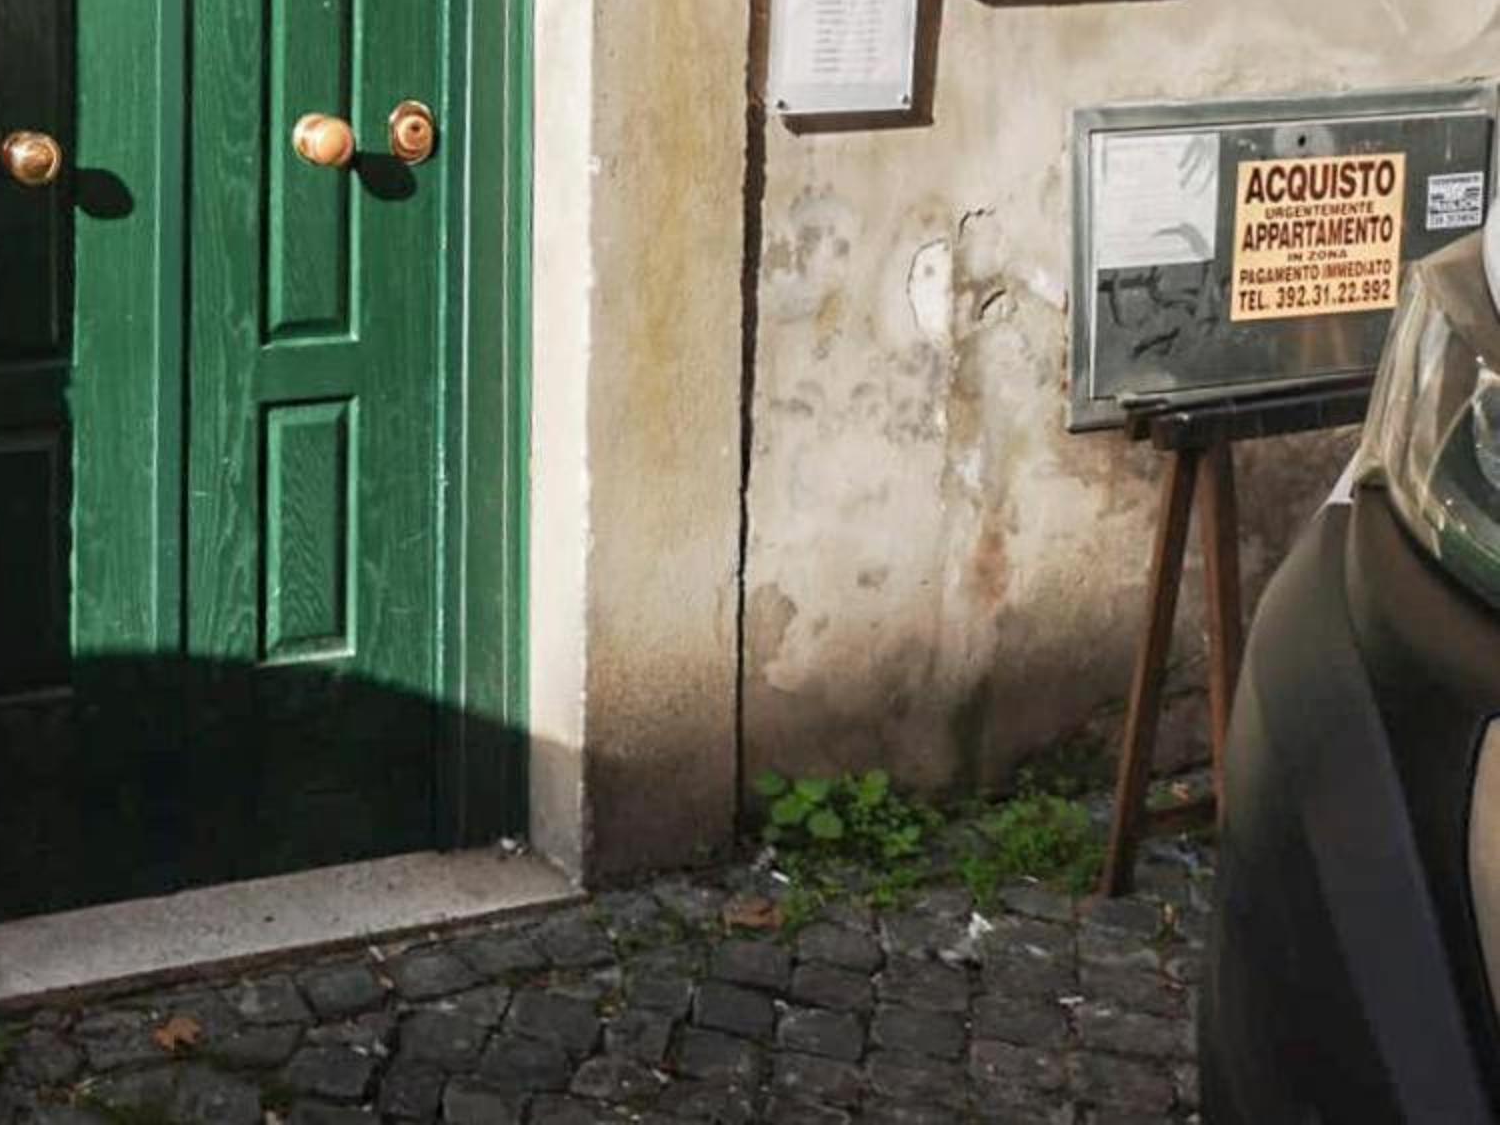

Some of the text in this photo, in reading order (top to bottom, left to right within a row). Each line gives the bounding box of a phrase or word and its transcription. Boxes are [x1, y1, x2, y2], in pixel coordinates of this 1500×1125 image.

[1245, 159, 1395, 204] ACQUISTO
[1265, 201, 1375, 219] URGENTEMENTE
[1242, 214, 1393, 251] APPARTAMENTO
[1287, 249, 1348, 262] IN ZONA
[1239, 259, 1392, 285] PAGAMENTO IMMEDIATO
[1239, 279, 1391, 311] TEL. 392.31.22.992
